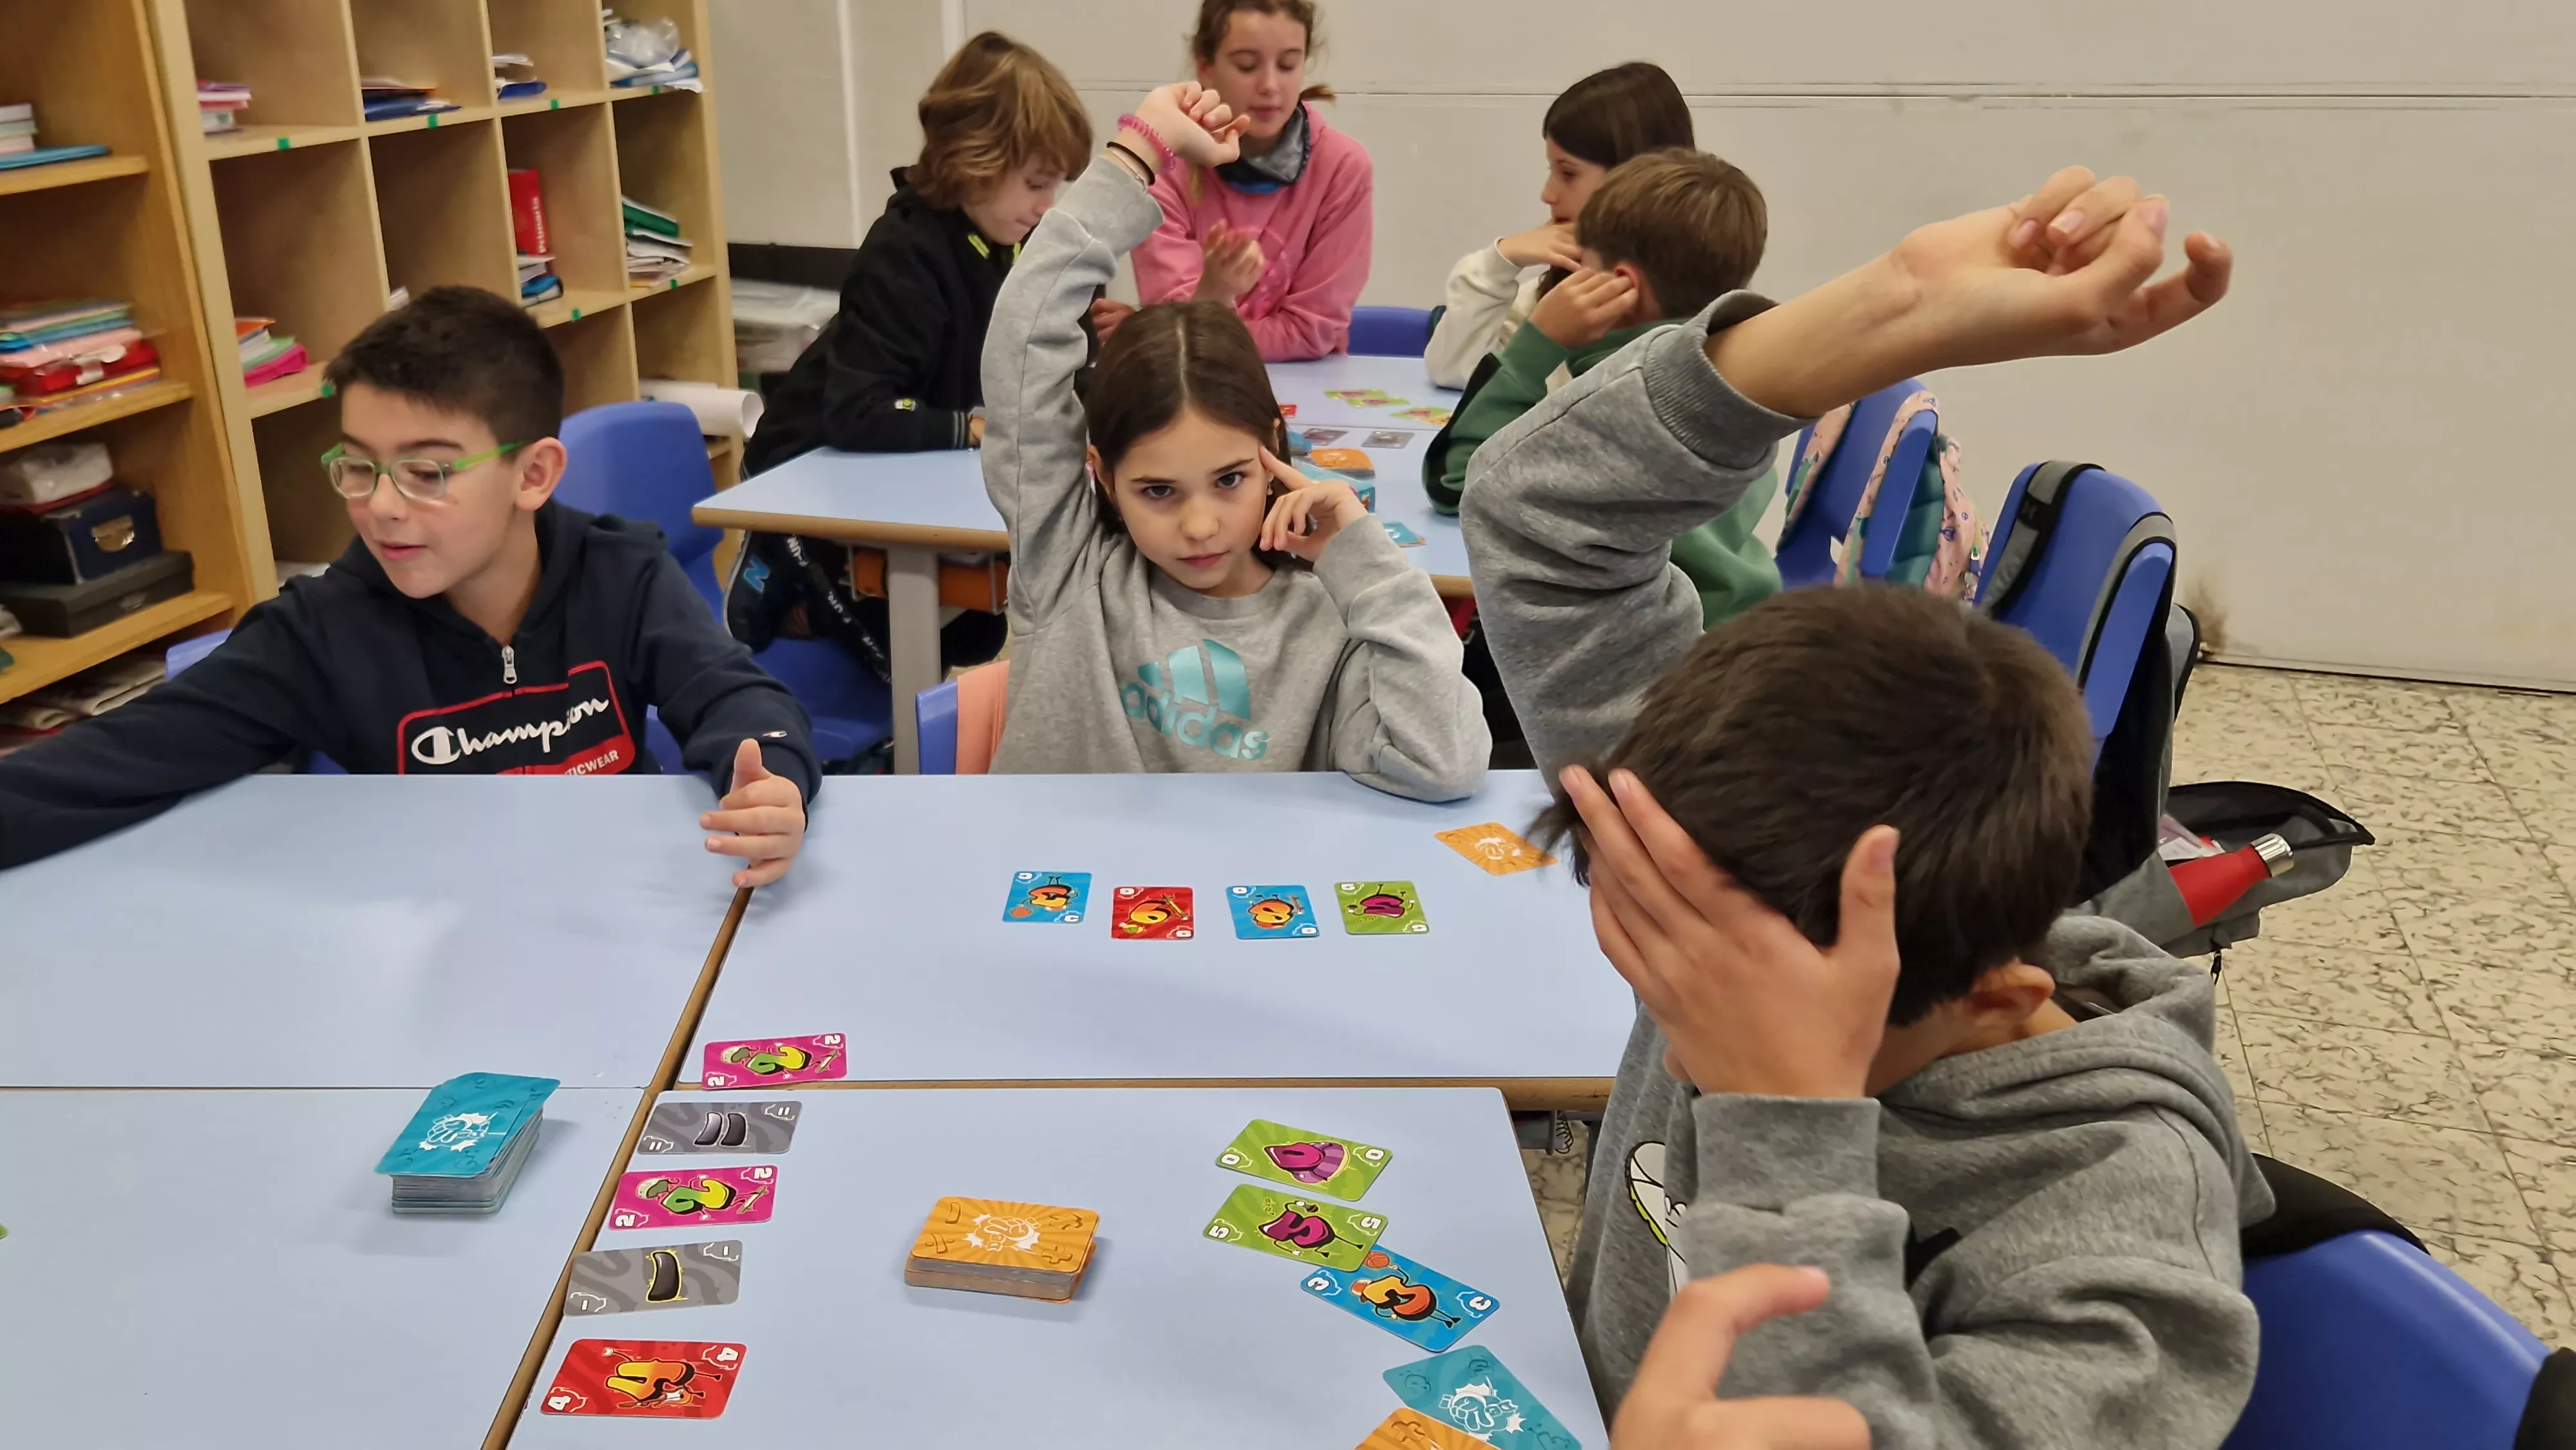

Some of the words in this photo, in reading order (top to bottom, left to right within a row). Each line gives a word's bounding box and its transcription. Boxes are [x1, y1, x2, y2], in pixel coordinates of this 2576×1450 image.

[1121, 683, 1271, 760] adidas
[412, 698, 609, 765] Champion
[825, 1035, 841, 1044] 2
[746, 1046, 813, 1075] 2
[708, 1077, 724, 1086] 2
[753, 1168, 772, 1179] 2
[661, 1179, 737, 1214] 2
[615, 1214, 636, 1227] 2
[1258, 1209, 1335, 1248] 5
[1360, 1216, 1382, 1230] 5
[1209, 1225, 1230, 1238] 5
[1361, 1275, 1437, 1321] 3
[717, 1347, 739, 1362] 4
[606, 1359, 695, 1402] 4
[547, 1395, 572, 1411] 4
